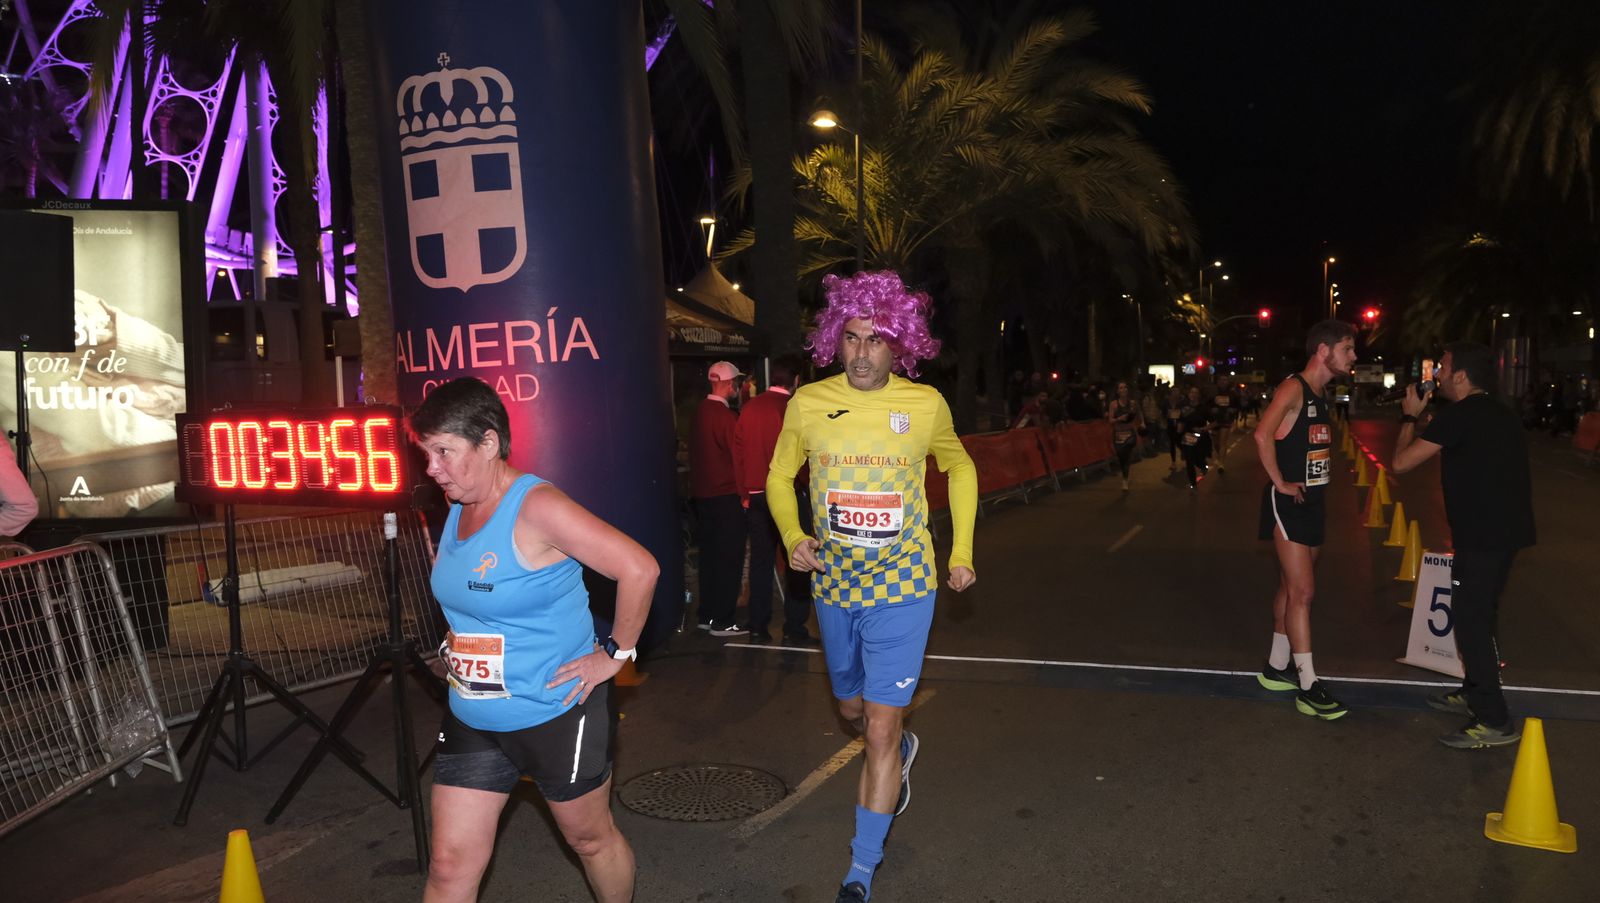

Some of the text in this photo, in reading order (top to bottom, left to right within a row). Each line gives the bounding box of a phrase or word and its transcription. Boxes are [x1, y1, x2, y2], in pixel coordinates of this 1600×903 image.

[42, 201, 92, 209] JCDecaux
[396, 306, 600, 374] ALMERÍA
[25, 349, 128, 382] con f de
[24, 377, 135, 410] futuro
[209, 418, 399, 491] 00:34:56
[840, 510, 892, 528] 3093
[1428, 586, 1455, 638] 5
[448, 656, 490, 679] 275
